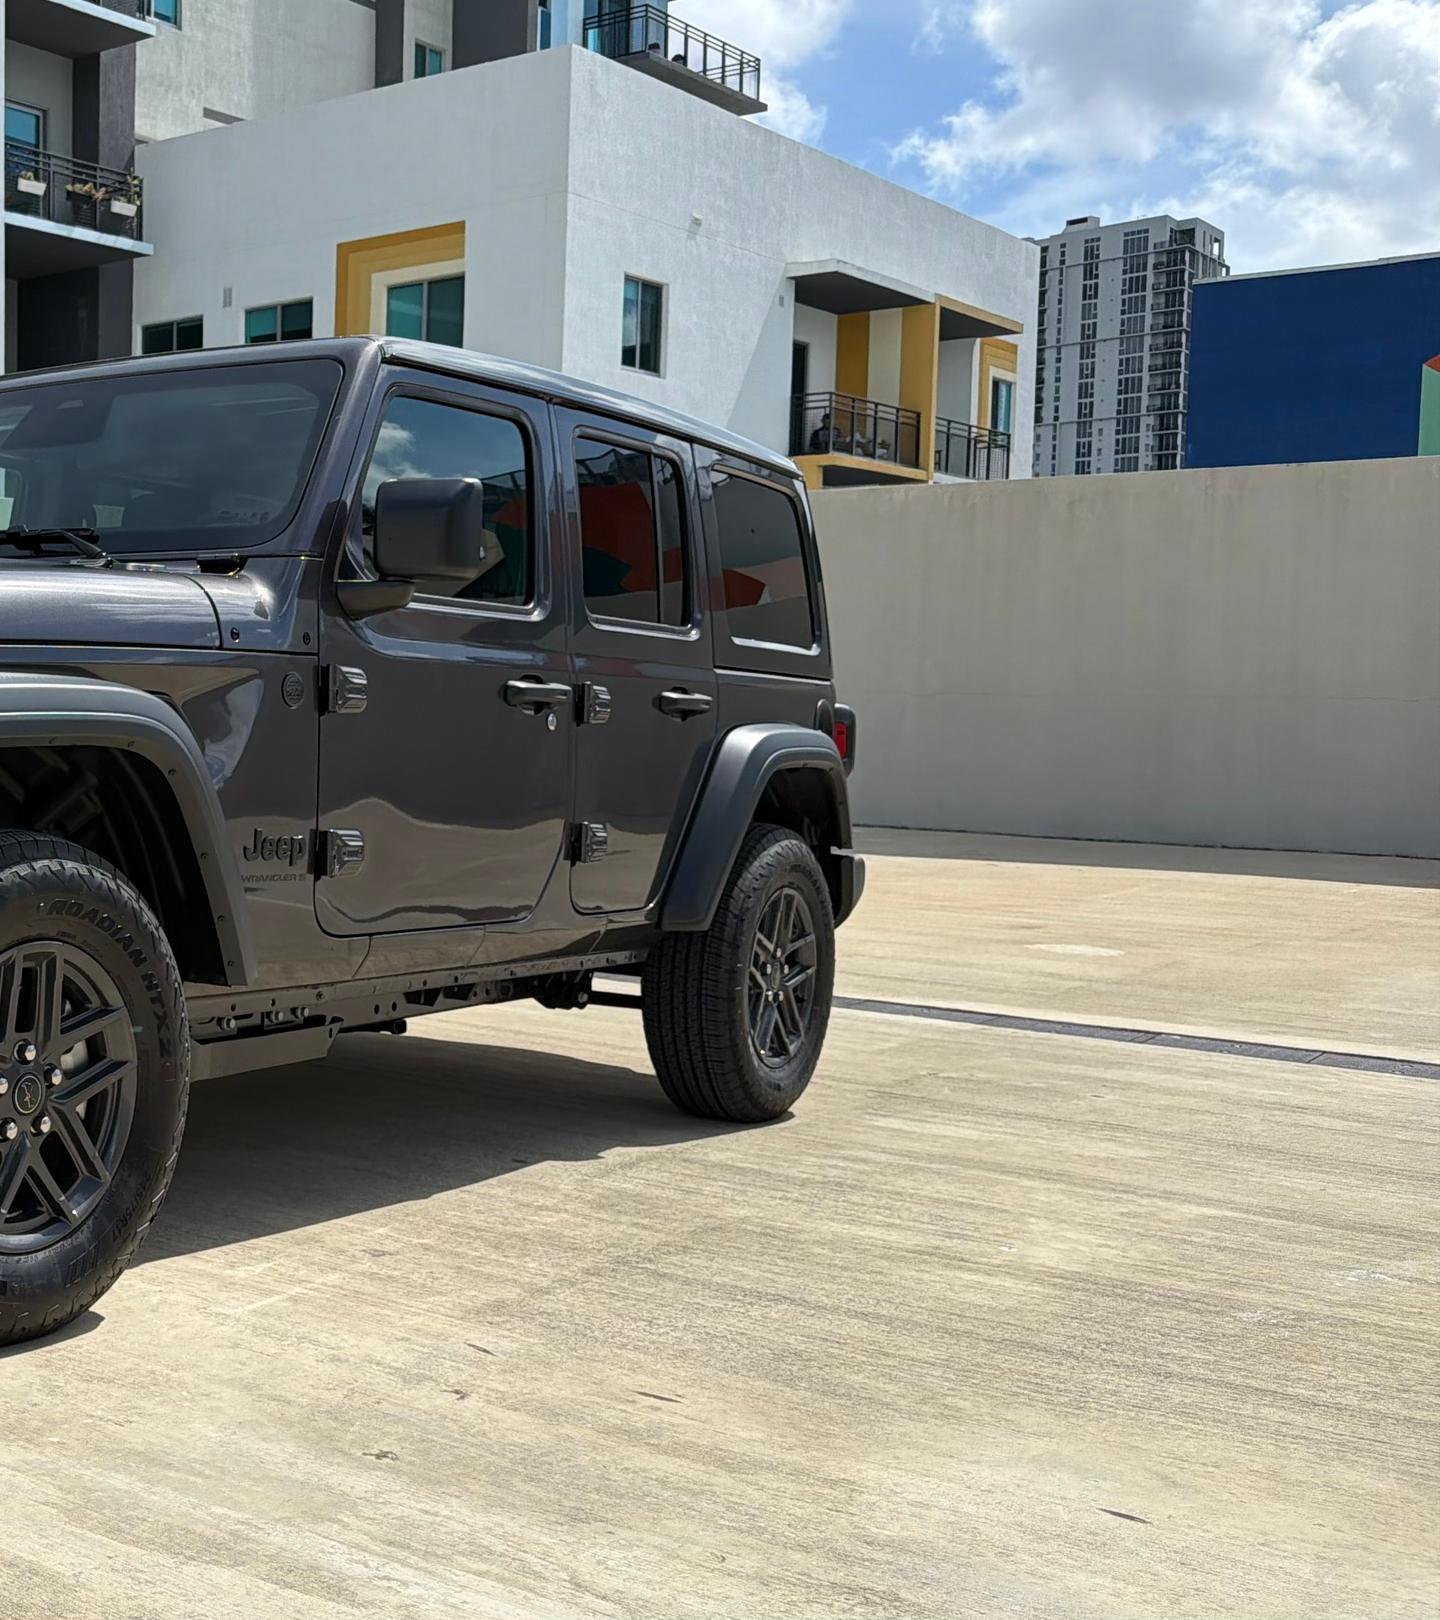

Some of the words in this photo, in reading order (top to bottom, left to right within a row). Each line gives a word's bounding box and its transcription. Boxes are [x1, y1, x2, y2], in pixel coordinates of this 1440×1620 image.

[243, 828, 306, 867] Jeep
[240, 873, 297, 883] WRANGLER
[47, 898, 148, 968] ROADIAN
